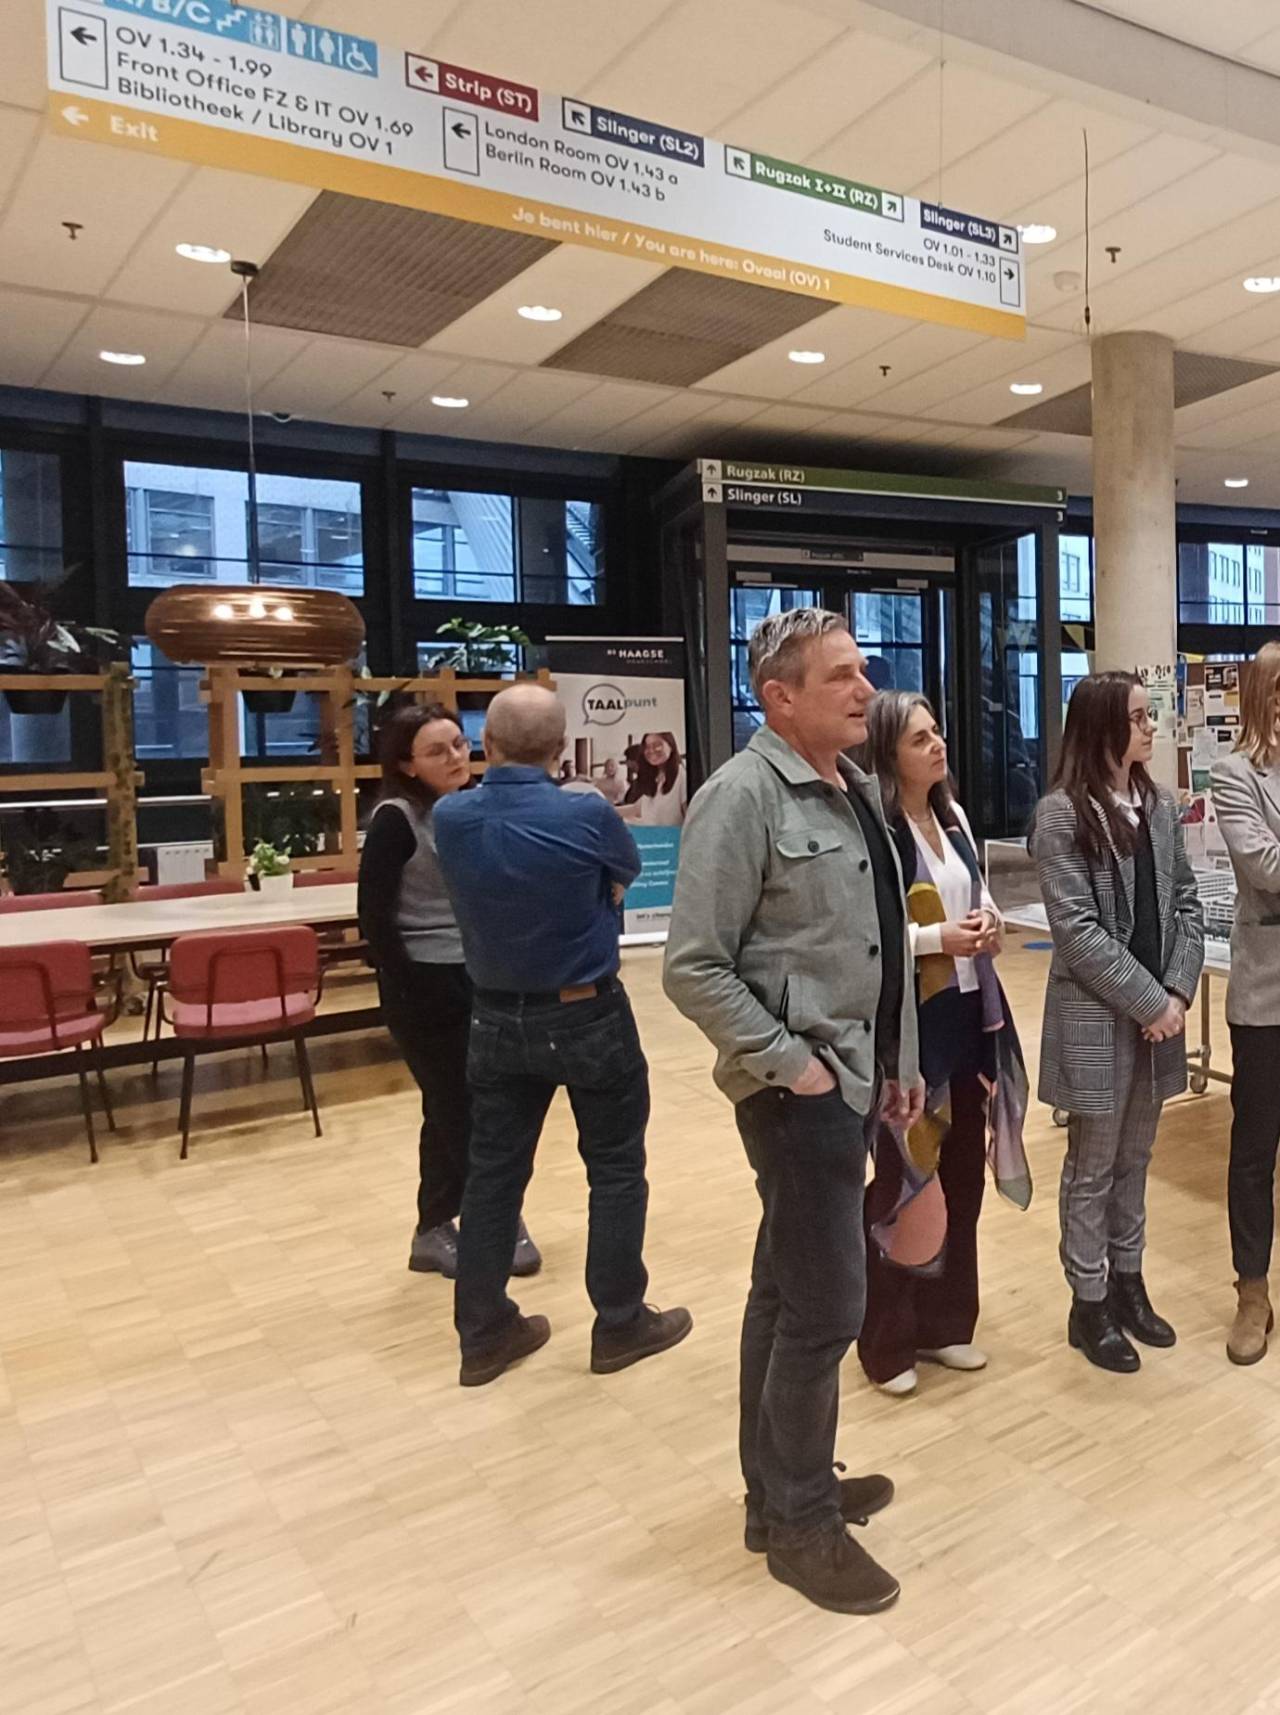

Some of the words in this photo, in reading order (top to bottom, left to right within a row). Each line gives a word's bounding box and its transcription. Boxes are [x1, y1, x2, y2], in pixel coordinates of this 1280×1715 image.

[116, 26, 151, 48] OV
[160, 38, 204, 62] 1.34
[229, 56, 272, 78] 1.99
[117, 51, 179, 81] Front
[186, 69, 256, 99] Office
[263, 87, 288, 108] FZ
[295, 95, 308, 112] &
[315, 100, 332, 117] IT
[339, 106, 368, 126] OV
[375, 116, 413, 136] 1.69
[118, 76, 244, 121] Bibliotheek
[252, 109, 261, 124] /
[269, 113, 343, 148] Library
[350, 132, 379, 151] OV
[386, 141, 392, 154] 1
[445, 72, 492, 101] Strip
[497, 87, 532, 114] (ST)
[110, 115, 158, 141] Exit
[597, 116, 656, 145] Slinger
[660, 133, 699, 160] (SL2)
[485, 121, 549, 150] London
[554, 140, 600, 164] Room
[605, 154, 629, 171] OV
[634, 162, 664, 181] 1.43
[668, 173, 678, 185] a
[486, 143, 534, 168] Berlin
[540, 157, 586, 181] Room
[591, 171, 615, 188] OV
[620, 179, 651, 198] 1.43
[656, 187, 665, 201] b
[755, 161, 811, 189] Rugzak
[815, 178, 846, 199] I+II
[849, 187, 879, 210] (RZ)
[512, 207, 535, 224] Je
[539, 211, 581, 234] bent
[585, 222, 618, 242] hier
[622, 231, 631, 245] /
[634, 234, 666, 254] You
[669, 245, 696, 260] are
[700, 249, 738, 270] here:
[742, 259, 786, 281] Ovaal
[789, 270, 821, 290] (OV)
[824, 279, 831, 291] 1
[923, 209, 966, 232] Slinger
[967, 221, 997, 243] (SL3)
[824, 228, 873, 254] Student
[876, 242, 925, 265] Services
[927, 255, 954, 273] Desk
[957, 263, 974, 277] OV
[977, 269, 996, 284] 1.10
[923, 238, 940, 252] OV
[943, 243, 964, 258] 1.01
[975, 252, 996, 267] 1.33
[727, 465, 776, 481] Rugzak
[779, 468, 805, 483] (RZ)
[727, 488, 775, 505] Slinger
[777, 490, 802, 505] (SL)
[618, 649, 665, 659] HAAGSE
